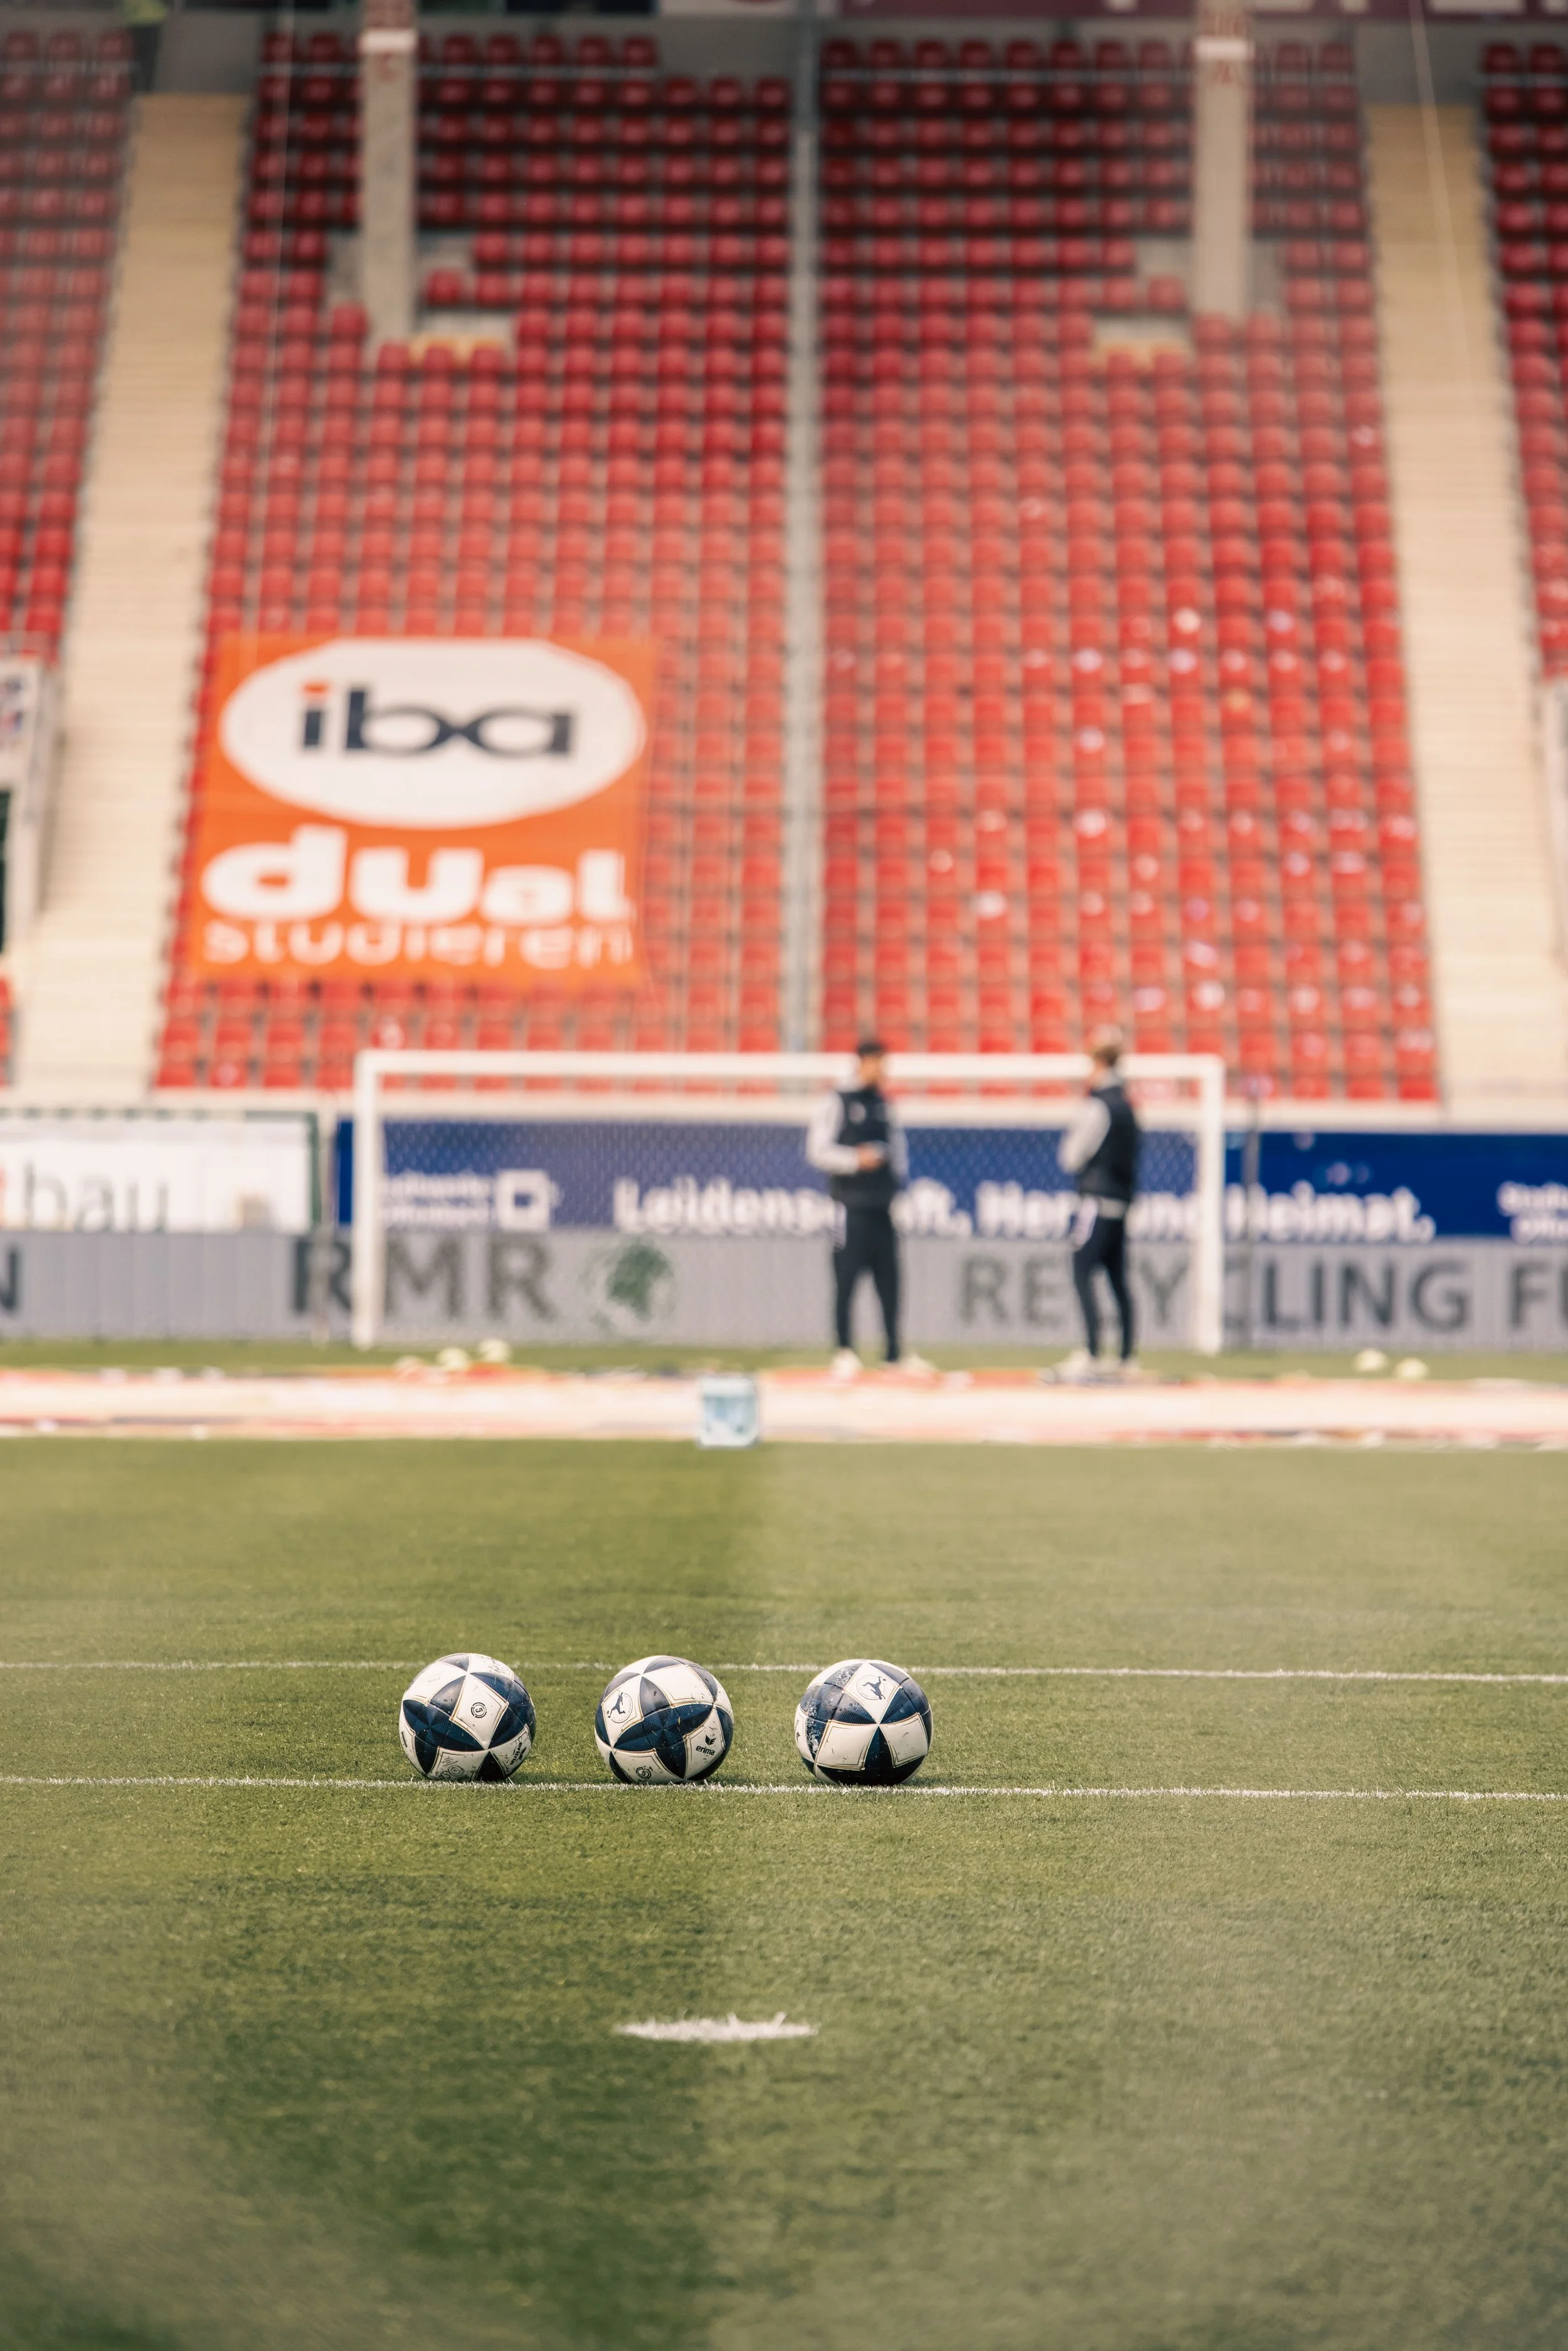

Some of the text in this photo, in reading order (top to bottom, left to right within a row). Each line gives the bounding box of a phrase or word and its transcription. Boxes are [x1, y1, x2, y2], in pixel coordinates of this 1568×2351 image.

[300, 682, 575, 757] iba
[202, 824, 636, 926] dual
[203, 922, 633, 969] studieren
[975, 1179, 1081, 1239] Her
[291, 1237, 559, 1319] RMR
[962, 1256, 1470, 1334] REYLING
[696, 1745, 716, 1756] erima
